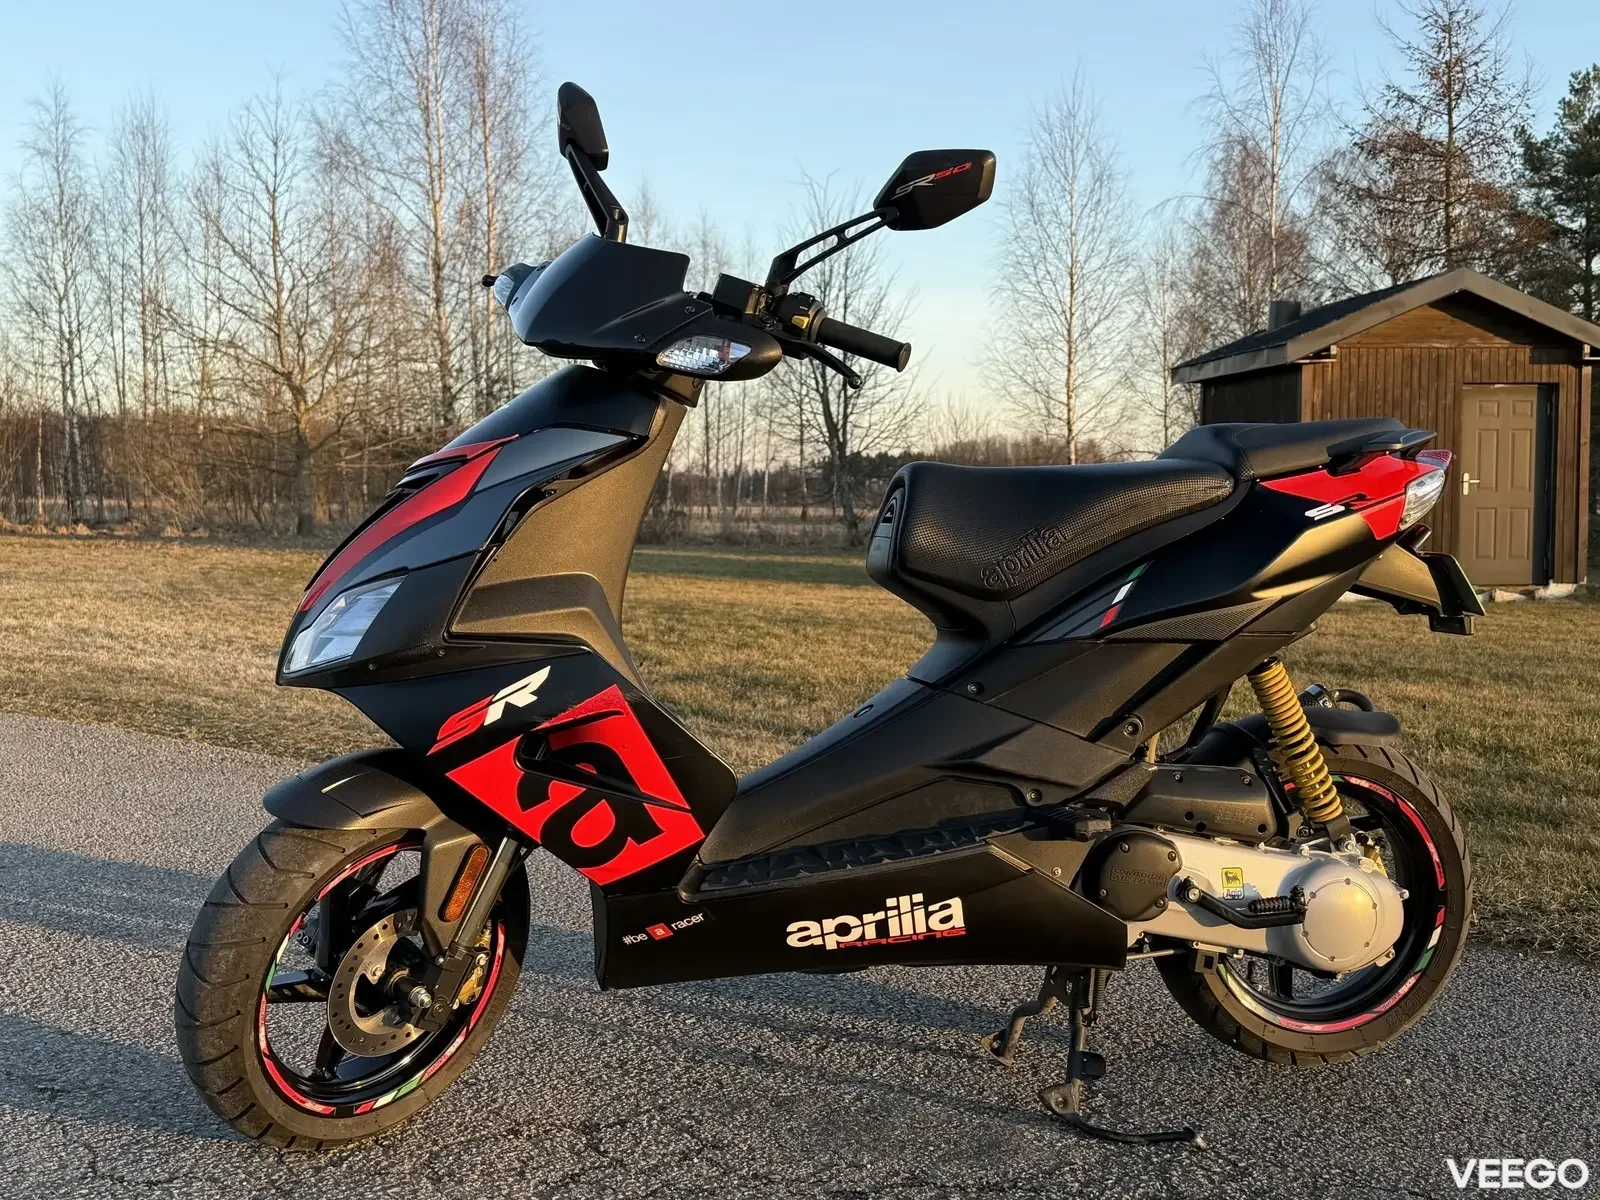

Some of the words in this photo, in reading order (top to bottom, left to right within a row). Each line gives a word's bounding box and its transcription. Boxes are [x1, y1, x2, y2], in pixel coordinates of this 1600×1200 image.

[980, 526, 1068, 590] aprilia
[426, 665, 551, 756] SR
[786, 892, 966, 950] aprilia
[1225, 888, 1243, 899] Agip
[622, 933, 648, 945] #be
[671, 912, 705, 930] racer
